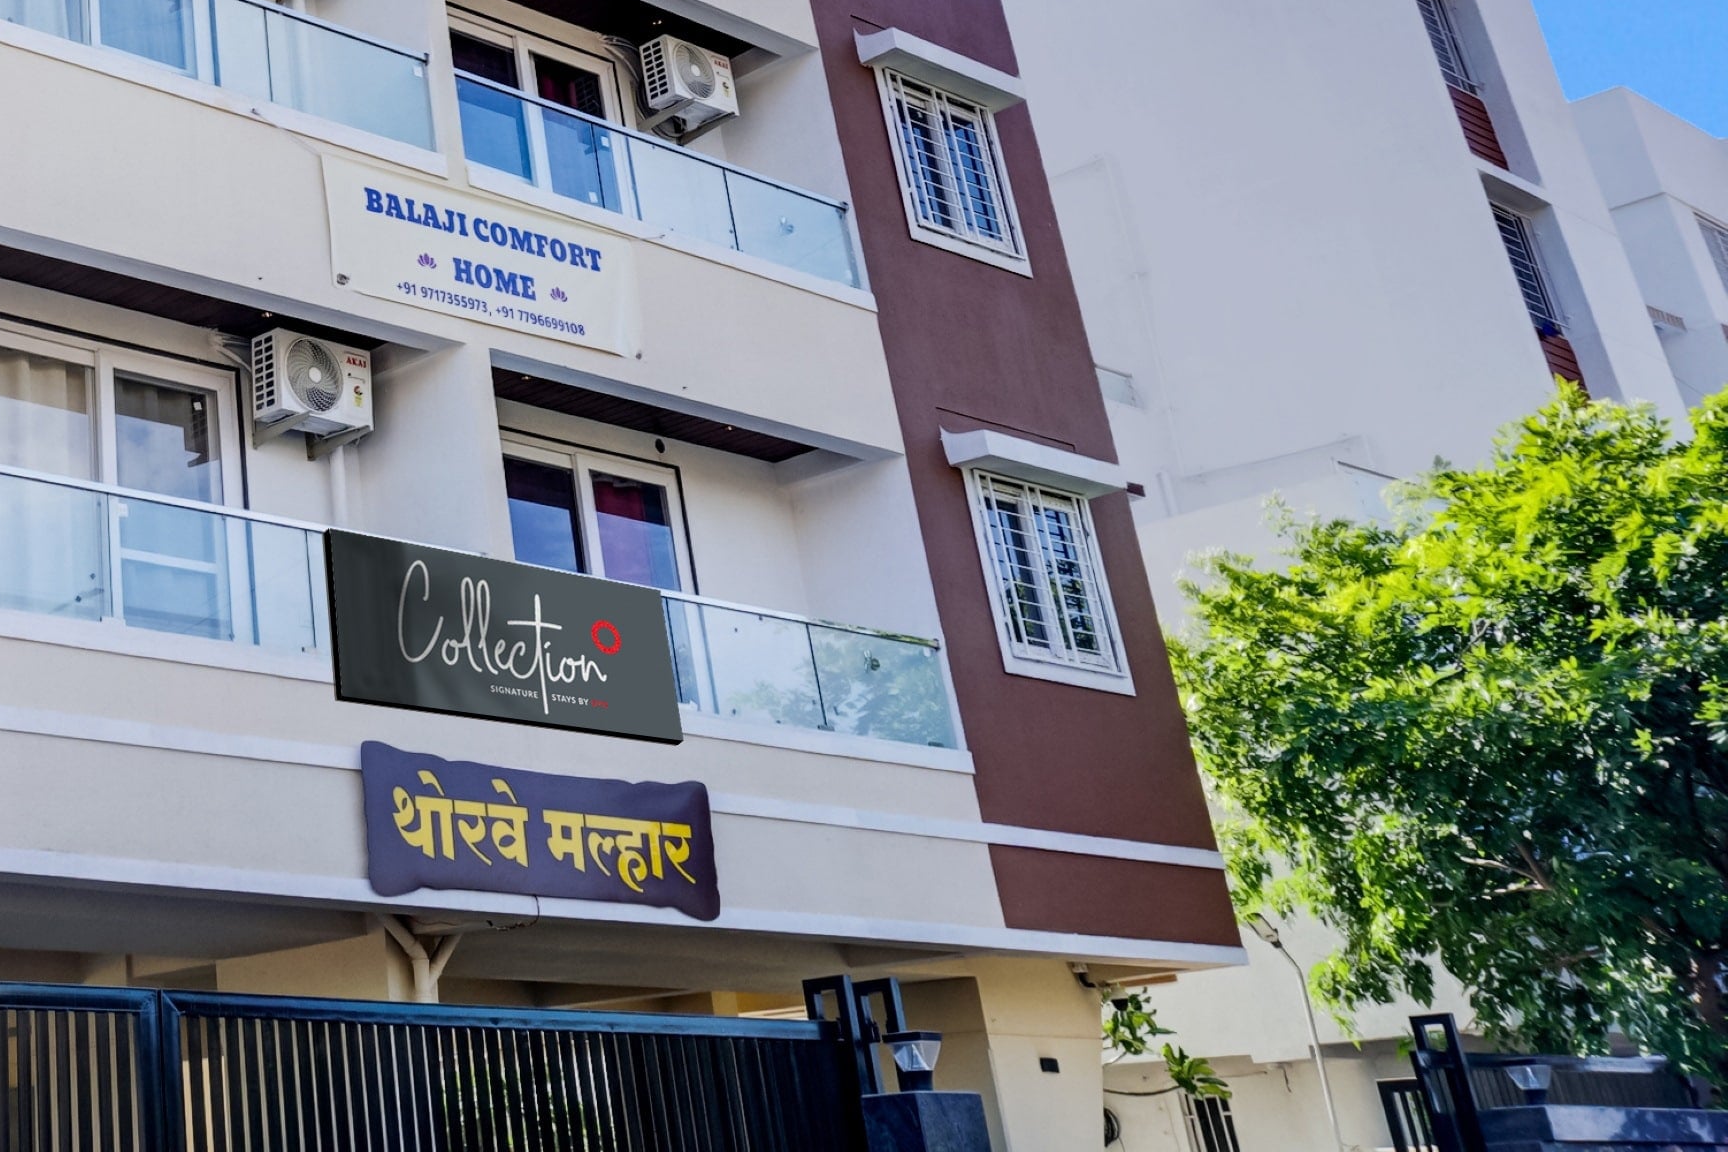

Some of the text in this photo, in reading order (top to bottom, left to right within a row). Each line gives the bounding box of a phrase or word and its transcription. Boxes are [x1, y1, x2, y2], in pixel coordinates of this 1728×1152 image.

[363, 186, 602, 272] BALAJI COMFORT
[396, 281, 417, 296] +91
[495, 305, 515, 320] +91
[452, 257, 537, 301] HOME
[345, 356, 368, 369] AKAI
[398, 559, 608, 715] Collection
[490, 684, 539, 700] SIGNATURE
[551, 693, 577, 705] STAYS
[578, 696, 590, 706] BY
[543, 808, 696, 893] मल्हार
